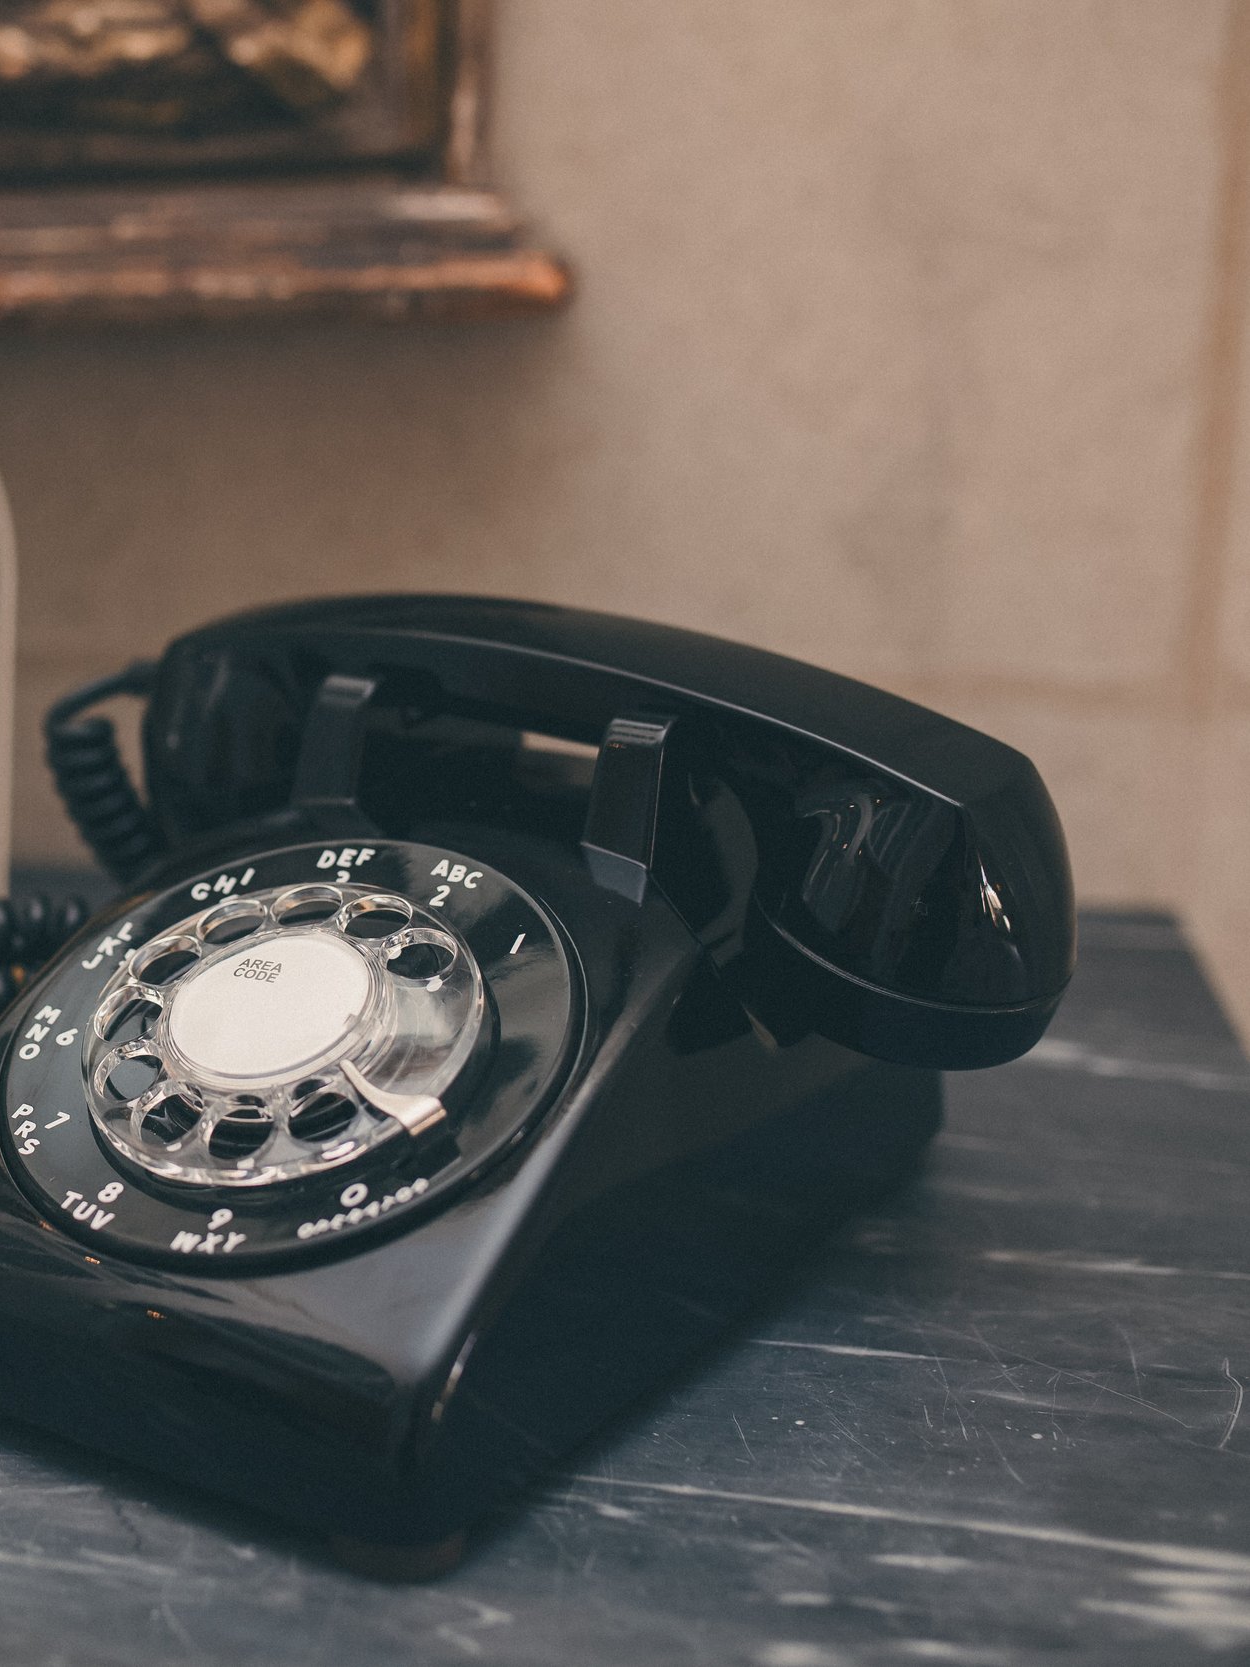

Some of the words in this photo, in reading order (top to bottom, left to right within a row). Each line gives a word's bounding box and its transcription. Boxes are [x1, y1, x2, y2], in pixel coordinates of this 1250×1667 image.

[316, 848, 376, 869] DEF
[190, 867, 256, 901] GHI
[430, 859, 484, 889] ABC
[429, 885, 451, 907] 2
[81, 922, 134, 969] JKL
[510, 933, 526, 954] 1
[233, 967, 280, 983] CODE
[238, 958, 282, 973] AREA
[18, 1005, 63, 1060] MNO
[55, 1028, 79, 1046] 6
[11, 1103, 41, 1155] PRS
[44, 1111, 71, 1129] 7
[97, 1181, 125, 1203] 8
[60, 1190, 116, 1231] TUV
[207, 1208, 234, 1231] 9
[169, 1230, 248, 1255] WXY
